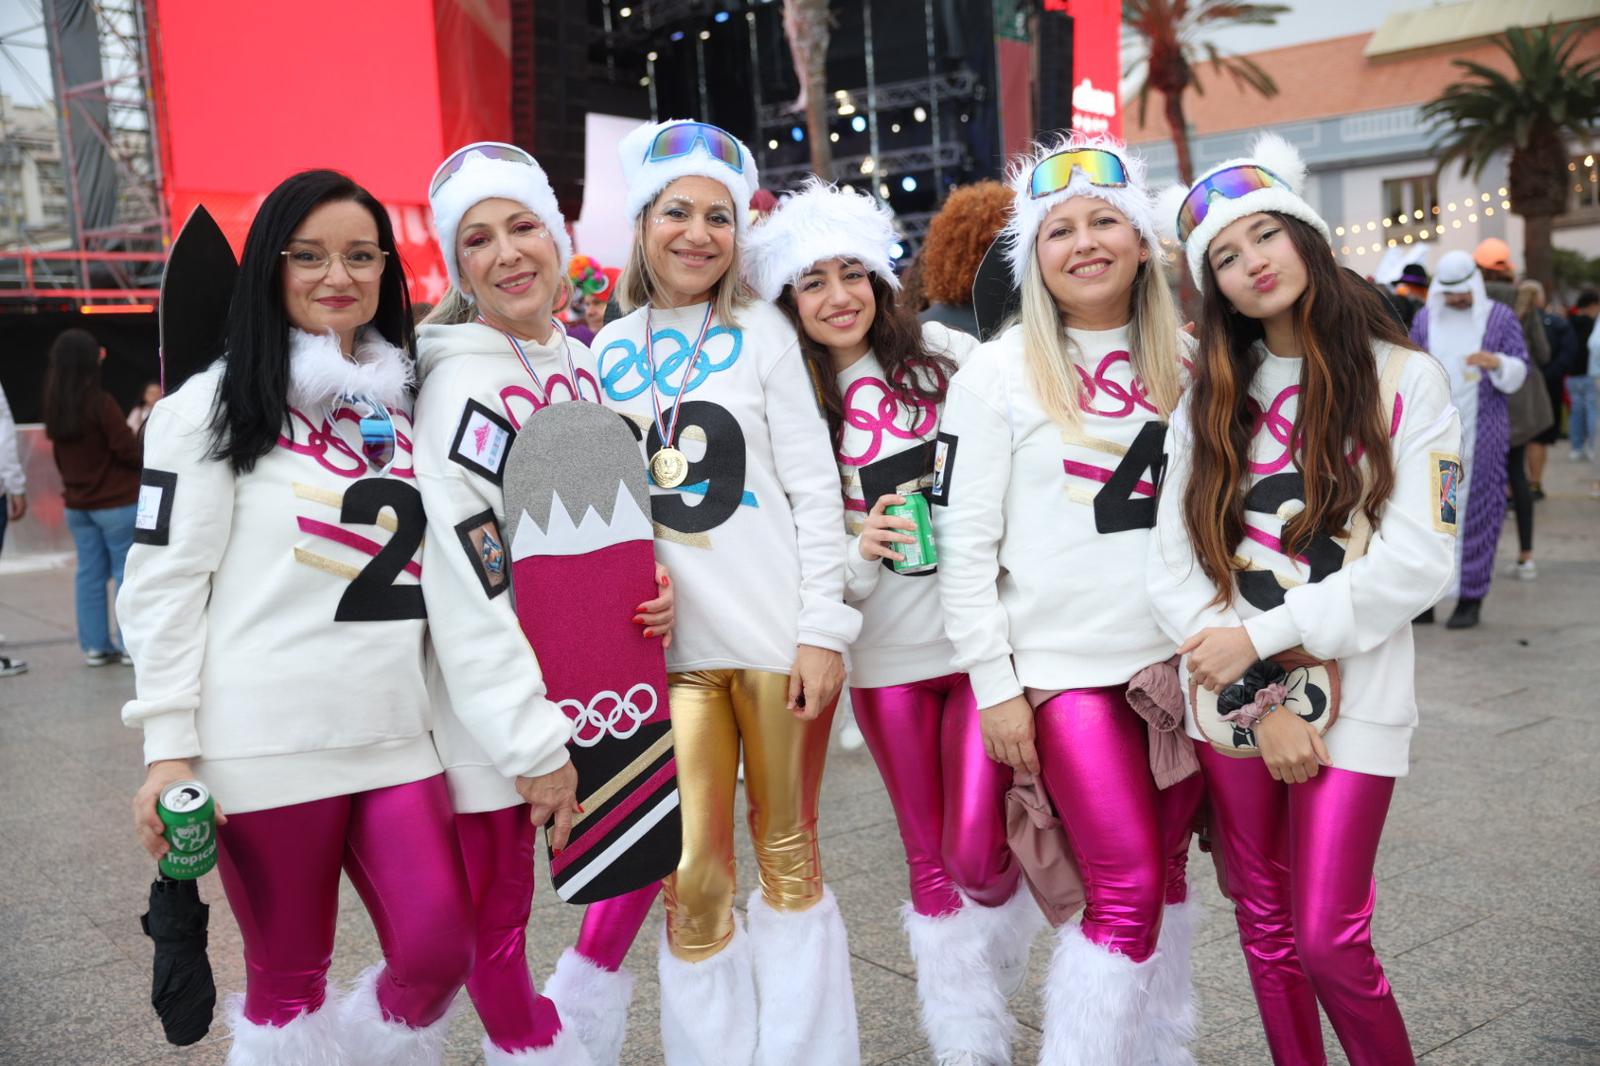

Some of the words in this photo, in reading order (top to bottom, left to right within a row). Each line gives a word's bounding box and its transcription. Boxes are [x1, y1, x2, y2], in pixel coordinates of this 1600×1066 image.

[646, 400, 746, 533] 9
[1093, 421, 1169, 534] 4
[334, 477, 428, 622] 2
